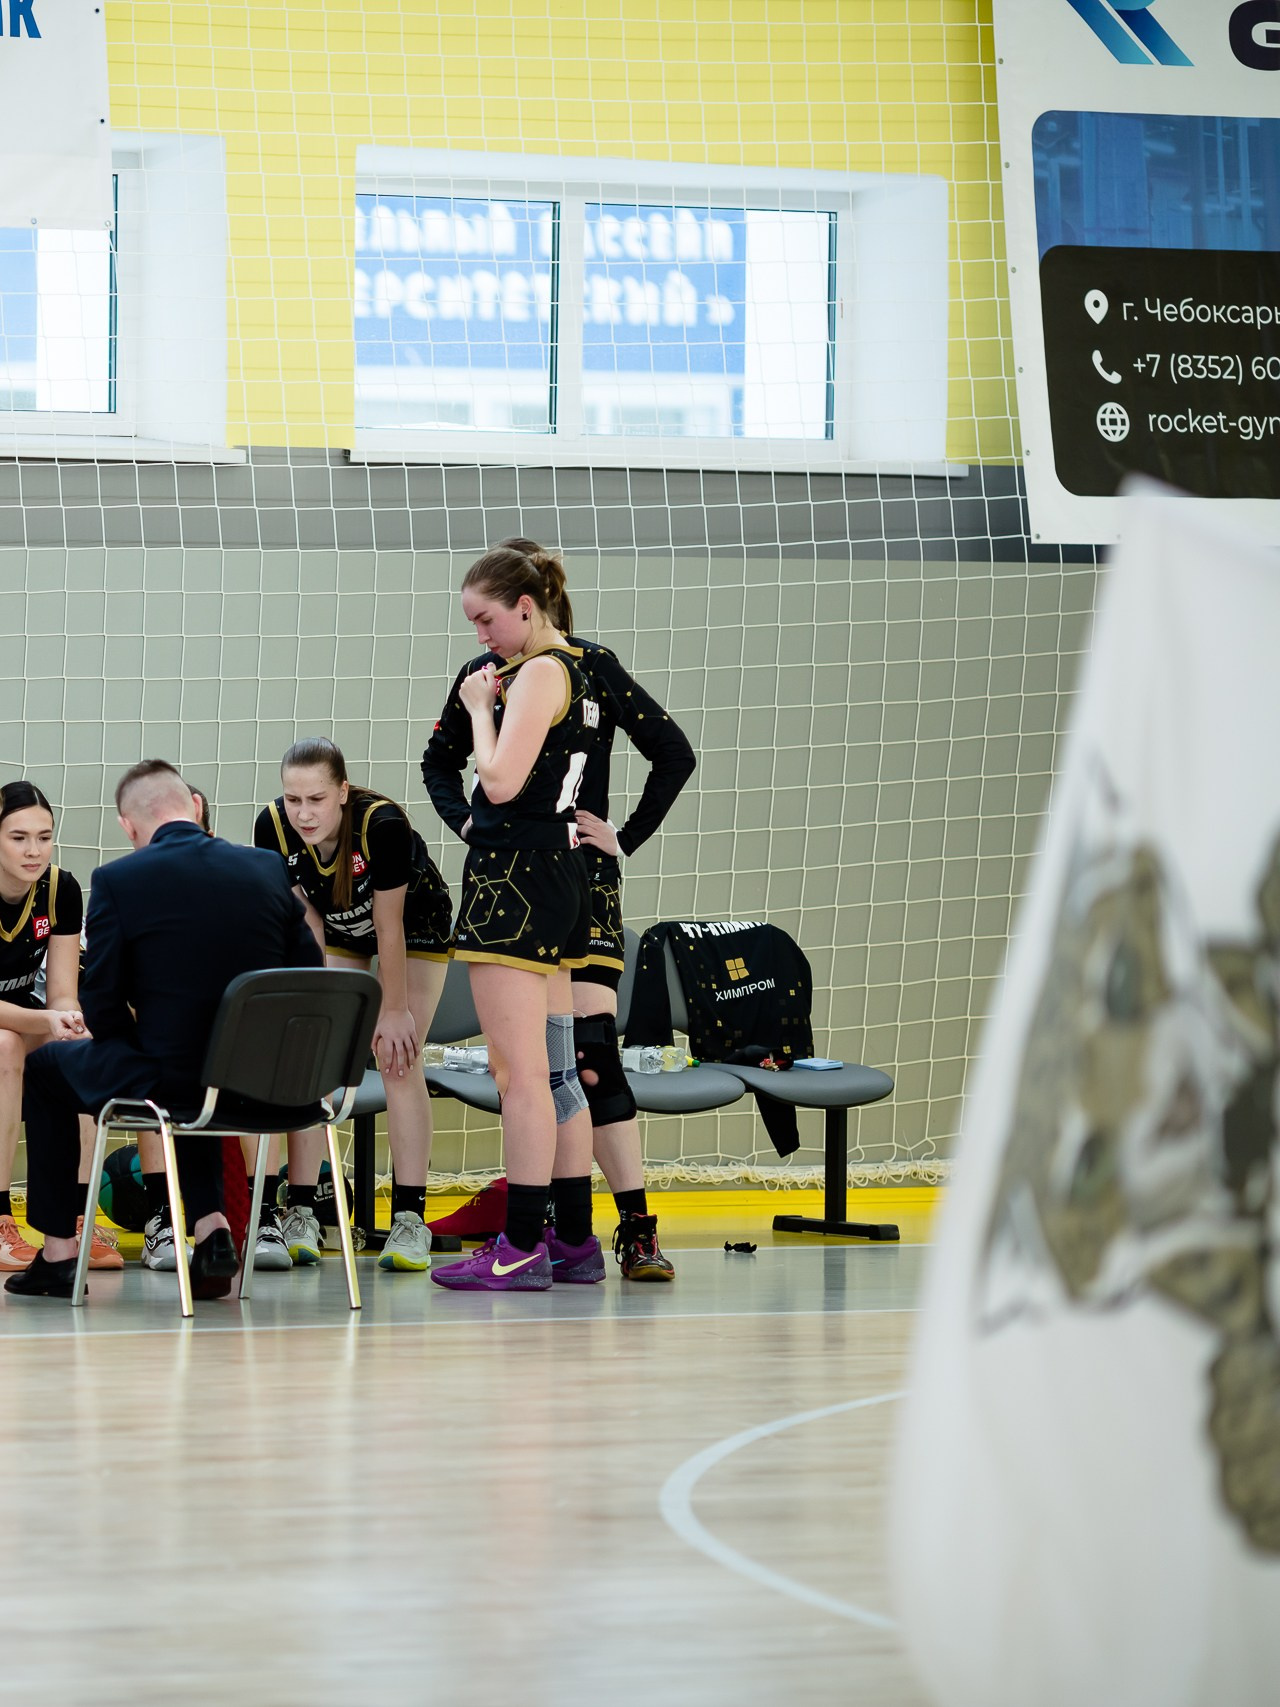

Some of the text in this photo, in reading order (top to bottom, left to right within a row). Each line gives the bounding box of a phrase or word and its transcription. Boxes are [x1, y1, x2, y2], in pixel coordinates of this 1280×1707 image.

[1122, 303, 1139, 322] г.
[1133, 353, 1280, 386] +7 (8352) 60
[715, 978, 776, 1002] ХИМПРОМ
